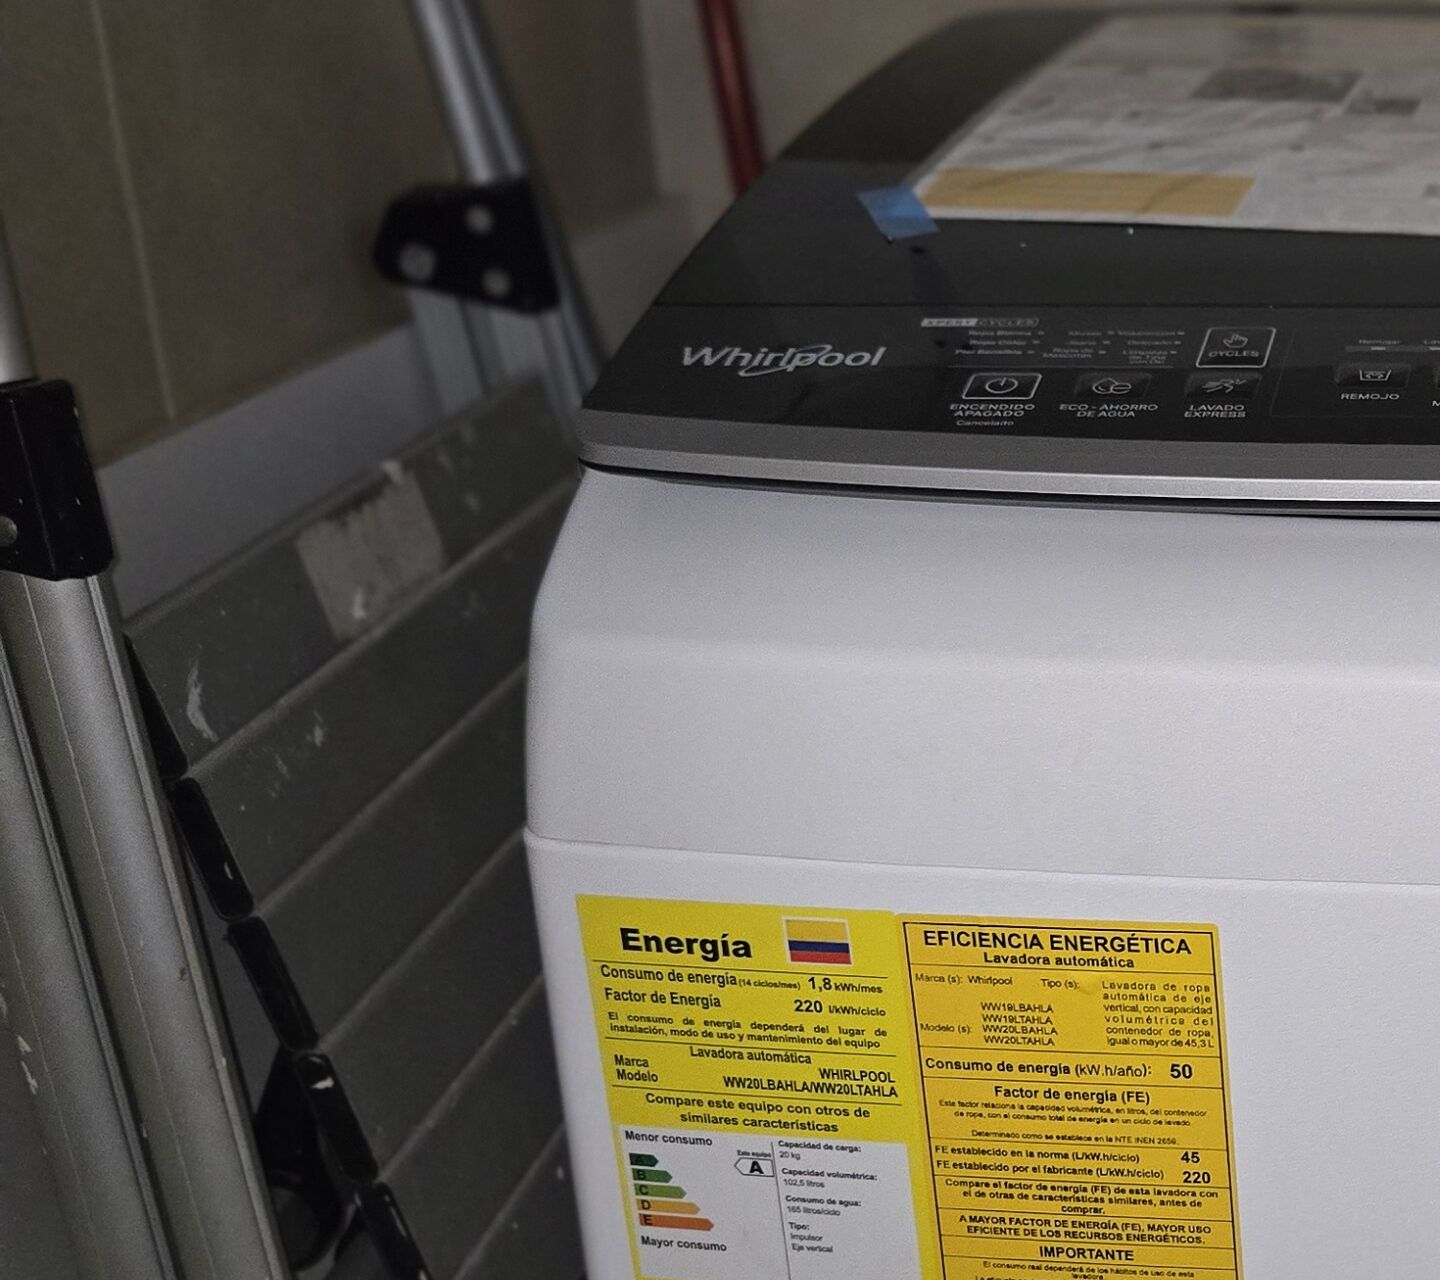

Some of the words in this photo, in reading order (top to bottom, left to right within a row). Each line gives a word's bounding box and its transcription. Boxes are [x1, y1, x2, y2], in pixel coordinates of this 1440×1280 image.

[681, 345, 888, 374] Whirlpool
[1208, 350, 1260, 358] CYCLES
[1340, 393, 1401, 401] REMOJO
[949, 403, 1036, 411] ENCENDIDO
[1058, 403, 1089, 411] ECO
[1099, 403, 1159, 411] AHORRO
[1076, 410, 1097, 418] DE
[1098, 410, 1136, 418] AGUA
[1183, 410, 1247, 418] EXPRESS
[1188, 404, 1245, 412] LAVADO
[619, 926, 752, 962] Energía
[922, 929, 1044, 950] EFICIENCIA
[1049, 932, 1192, 954] ENERGÉTICA
[982, 951, 1050, 965] Lavadora
[1054, 955, 1134, 968] automática
[599, 963, 664, 981] Consumo
[666, 968, 684, 982] de
[686, 971, 737, 988] energía
[737, 978, 752, 987] (14
[752, 979, 801, 991] ciclos/mes)
[807, 976, 832, 992] 1,8
[833, 981, 883, 994] kWh/mes
[603, 986, 647, 1002] Factor
[649, 990, 666, 1004] de
[669, 991, 721, 1010] Energía
[793, 998, 823, 1013] 220
[606, 1010, 619, 1020] El
[626, 1014, 674, 1024] consumo
[681, 1016, 695, 1026] de
[702, 1019, 742, 1030] energía
[749, 1020, 805, 1032] dependerá
[812, 1024, 829, 1034] del
[837, 1025, 865, 1037] lugar
[873, 1027, 887, 1037] de
[609, 1021, 668, 1036] instalación,
[669, 1027, 699, 1037] modo
[700, 1028, 714, 1038] de
[715, 1031, 736, 1040] uso
[736, 1032, 744, 1042] y
[745, 1033, 823, 1045] mantenimiento
[825, 1036, 842, 1046] del
[843, 1038, 880, 1049] equipo
[688, 1045, 744, 1060] Lavadora
[746, 1050, 812, 1064] automática
[613, 1053, 649, 1068] Marca
[817, 1067, 895, 1083] WHIRLPOOL
[924, 1056, 993, 1071] Consumo
[996, 1060, 1014, 1072] de
[1017, 1062, 1071, 1077] energía
[1169, 1062, 1193, 1079] 50
[615, 1067, 658, 1082] Modelo
[721, 1075, 898, 1098] WW20LBAHLA/WW20LTAHLA
[644, 1091, 704, 1108] Compare
[706, 1098, 734, 1109] este
[737, 1100, 783, 1114] equipo
[786, 1104, 811, 1114] con
[814, 1105, 850, 1117] otros
[853, 1106, 870, 1118] de
[993, 1085, 1039, 1098] Factor
[1042, 1087, 1060, 1100] de
[1063, 1089, 1117, 1104] energía
[1120, 1090, 1150, 1106] (FE)
[679, 1111, 739, 1126] similares
[741, 1117, 839, 1132] características
[624, 1129, 659, 1142] Menor
[661, 1134, 713, 1146] consumo
[934, 1144, 948, 1154] FE
[949, 1146, 1008, 1157] establecido
[1009, 1149, 1023, 1157] en
[1024, 1149, 1035, 1158] la
[1036, 1150, 1069, 1159] norma
[1180, 1150, 1200, 1164] 45
[635, 1169, 647, 1180] B
[747, 1159, 764, 1175] A
[935, 1159, 950, 1169] FE
[951, 1161, 1009, 1172] establecido
[1011, 1164, 1029, 1174] por
[1031, 1164, 1041, 1173] el
[1042, 1164, 1093, 1176] fabricante
[1181, 1170, 1211, 1184] 220
[637, 1184, 649, 1196] C
[640, 1199, 652, 1210] D
[642, 1214, 653, 1226] E
[958, 1214, 967, 1223] A
[968, 1214, 1007, 1225] MAYOR
[1007, 1216, 1051, 1227] FACTOR
[1053, 1218, 1069, 1228] DE
[1070, 1219, 1119, 1230] ENERGÍA
[1146, 1222, 1186, 1233] MAYOR
[1187, 1224, 1211, 1234] USO
[640, 1234, 674, 1249] Mayor
[676, 1240, 727, 1251] consumo
[966, 1224, 1020, 1236] EFICIENTE
[1022, 1227, 1037, 1237] DE
[1038, 1228, 1061, 1238] LOS
[1063, 1229, 1123, 1241] RECURSOS
[1125, 1232, 1205, 1244] ENERGÉTICOS.
[1038, 1245, 1134, 1261] IMPORTANTE
